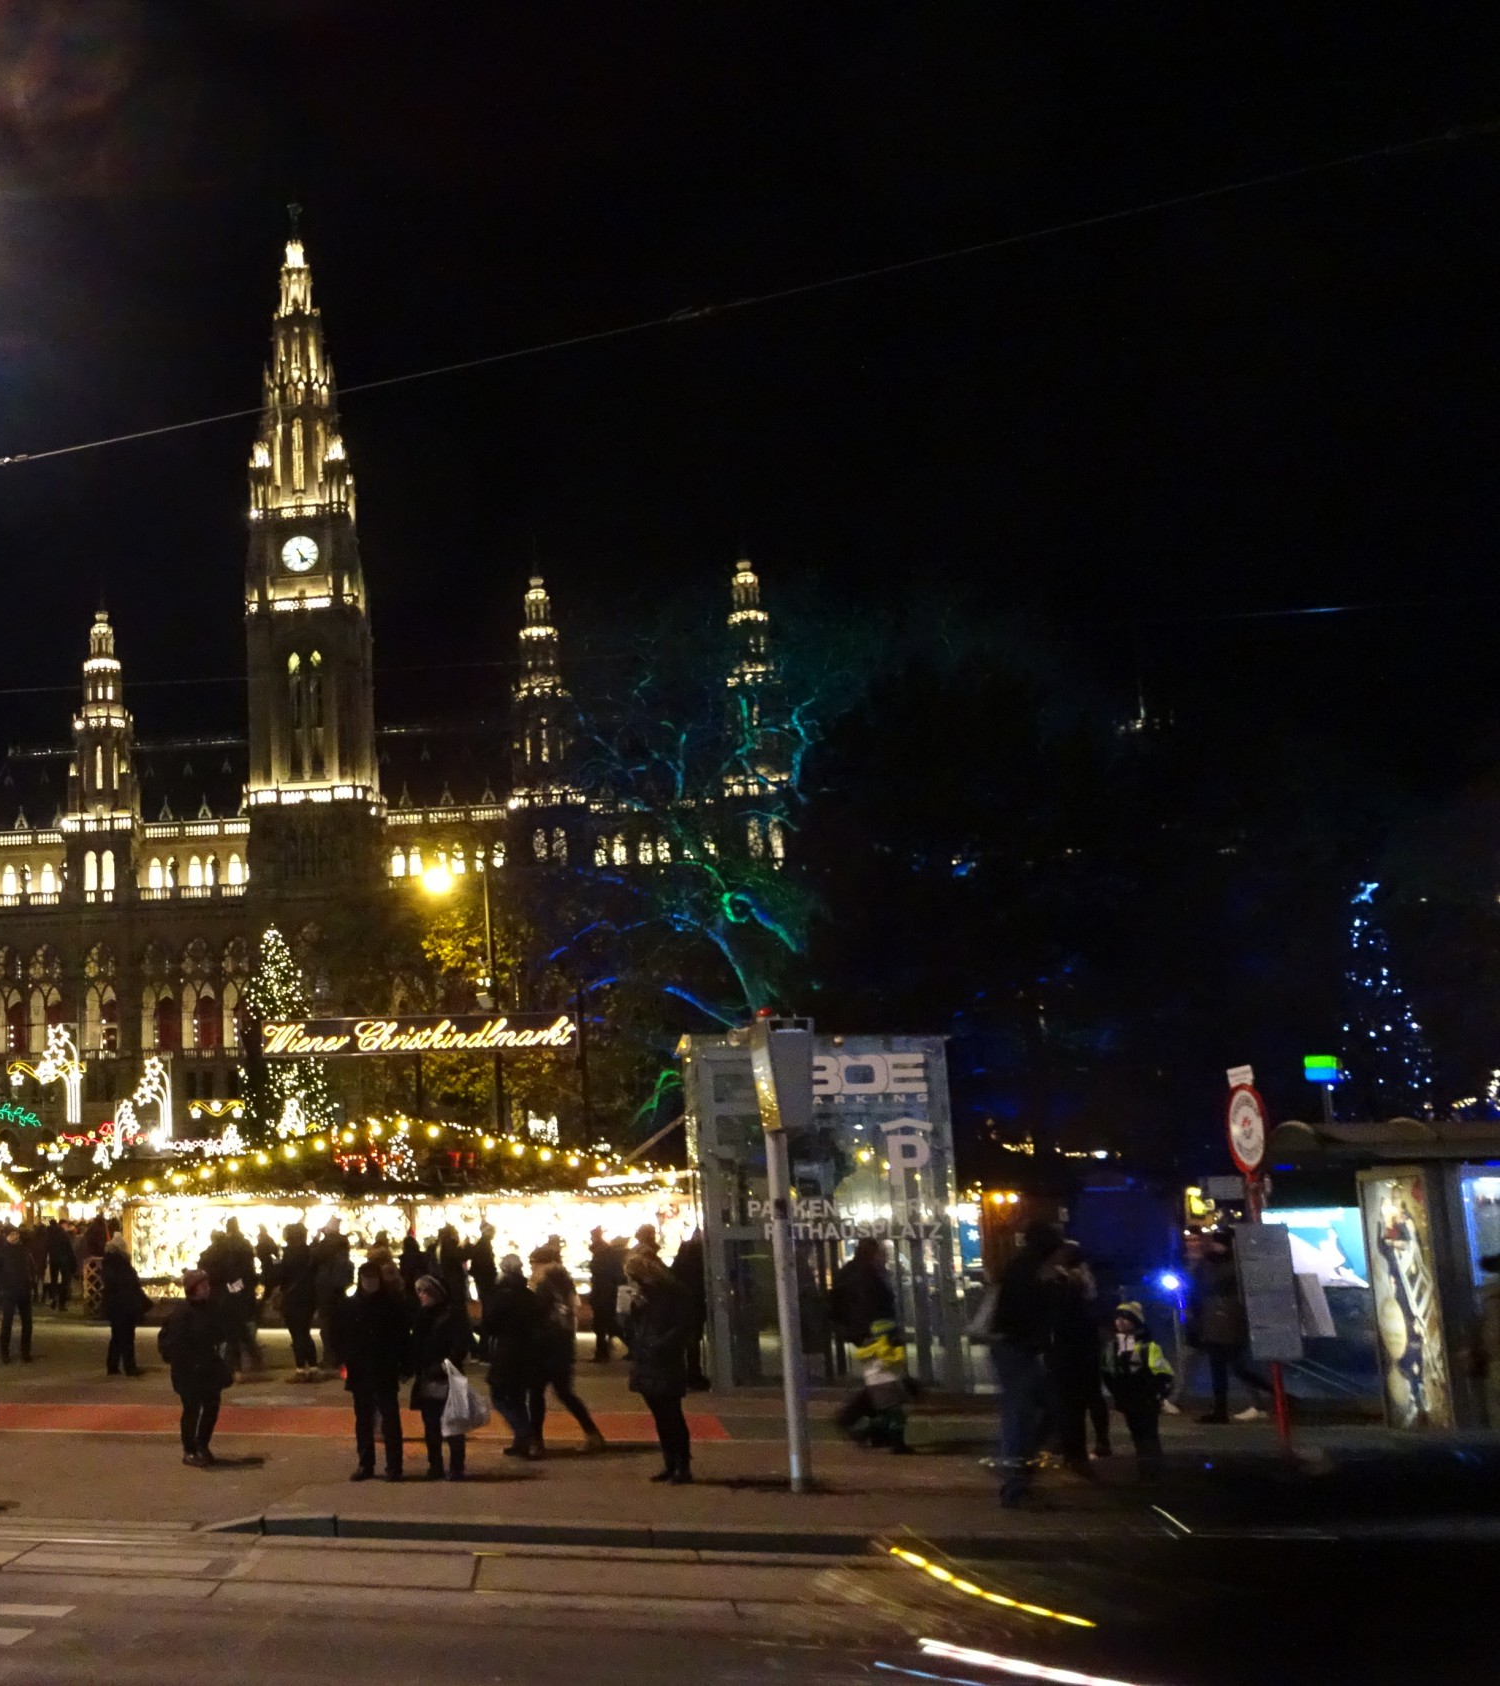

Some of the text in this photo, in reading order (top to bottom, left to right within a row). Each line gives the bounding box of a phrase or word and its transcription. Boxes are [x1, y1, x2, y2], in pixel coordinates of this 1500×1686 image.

[263, 1015, 577, 1054] Wiener Christkindlmarkt
[812, 1095, 928, 1104] ARKING
[748, 1200, 839, 1218] PAKEN
[765, 1219, 942, 1239] RTHAUSPLATZ
